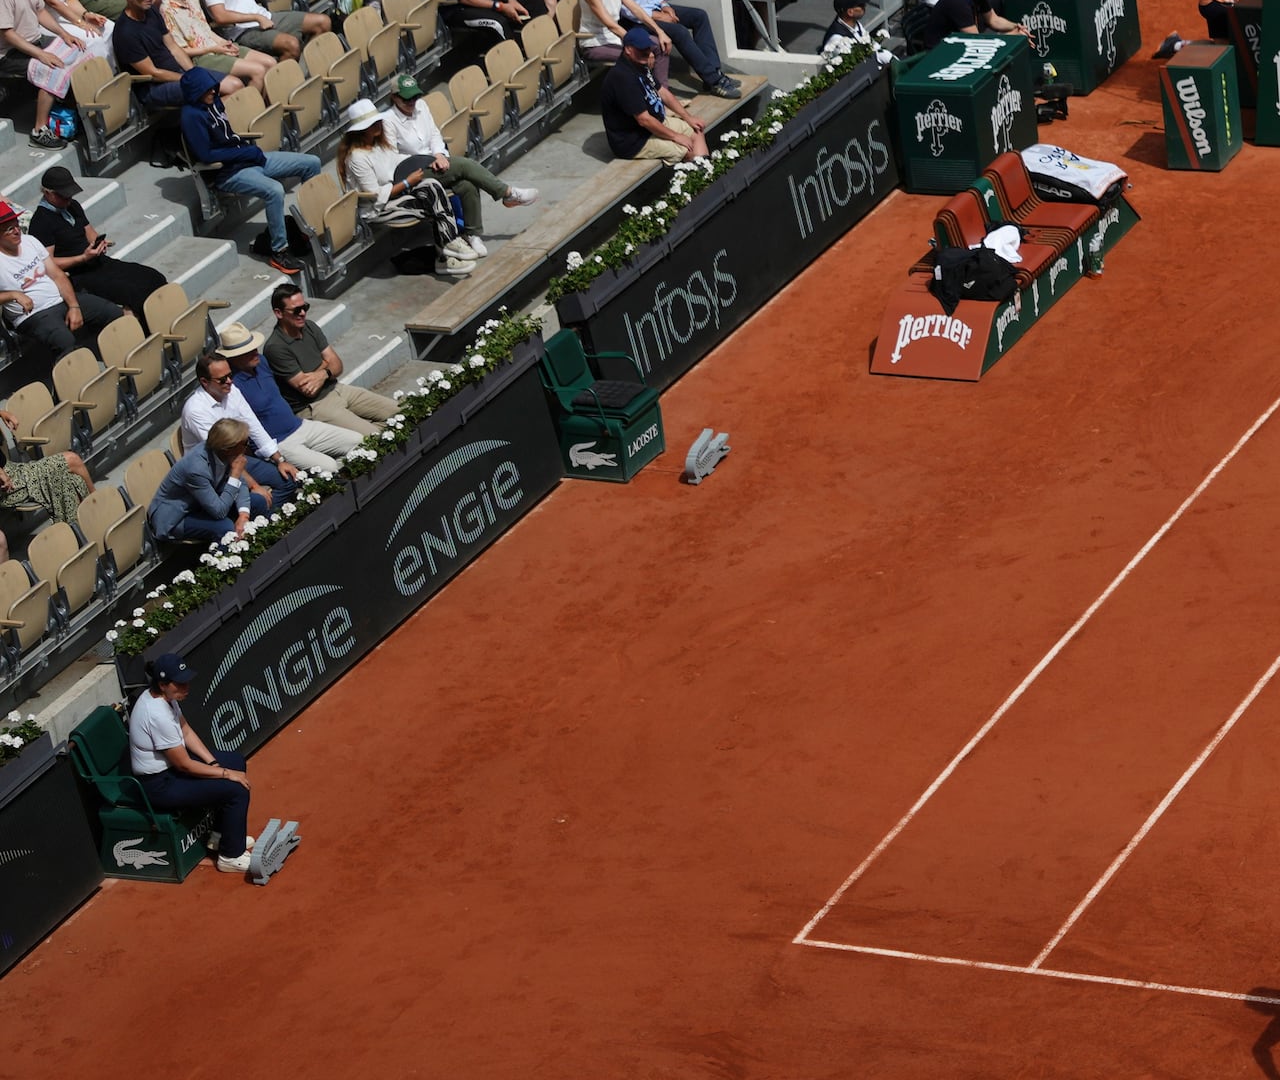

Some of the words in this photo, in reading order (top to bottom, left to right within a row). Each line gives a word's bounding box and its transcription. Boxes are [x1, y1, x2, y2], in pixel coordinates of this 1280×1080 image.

[1174, 75, 1212, 159] Wilson
[788, 120, 890, 240] Infosys
[623, 249, 738, 378] Infosys
[627, 423, 659, 458] LACOSTE
